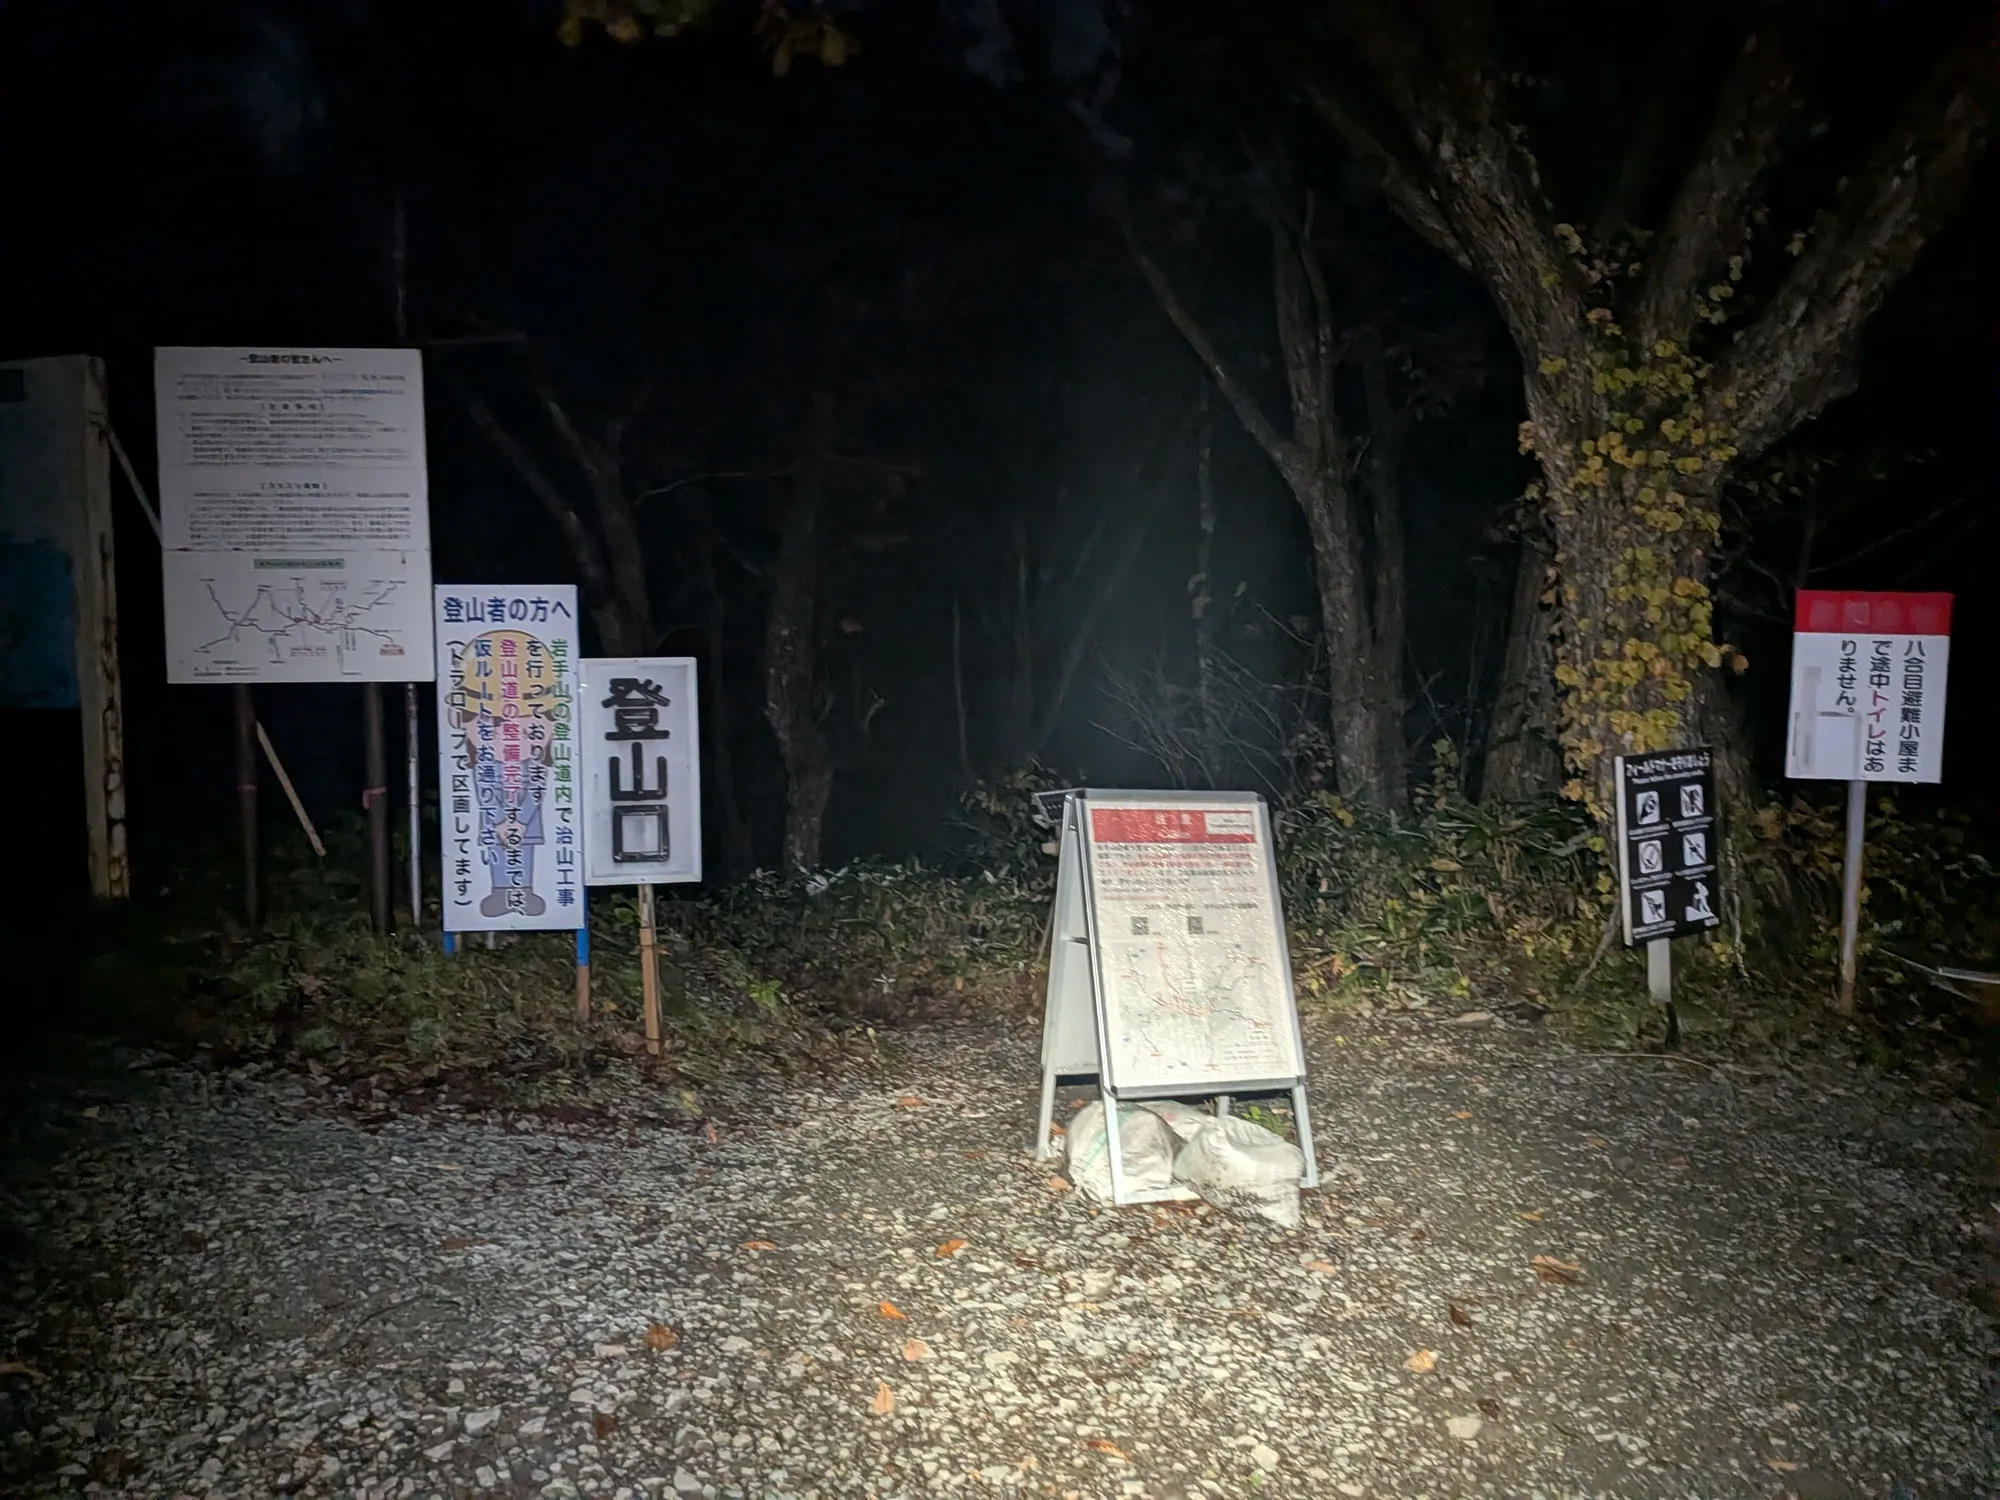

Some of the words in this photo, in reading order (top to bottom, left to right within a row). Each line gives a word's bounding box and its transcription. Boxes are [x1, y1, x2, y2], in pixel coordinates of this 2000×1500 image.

[443, 597, 571, 623] 登山者の方へ
[1835, 640, 1858, 713] りません。
[475, 639, 498, 866] 仮ルートをお通り下さい
[500, 639, 525, 916] 登山道の整備完了するまでは、
[525, 639, 547, 804] を行っております
[550, 638, 575, 907] 岩手山の登山道内で治山工事
[601, 678, 671, 863] 登山口
[1863, 640, 1893, 773] で途中トイレはあ
[1897, 640, 1926, 773] 八合目避難小屋ま
